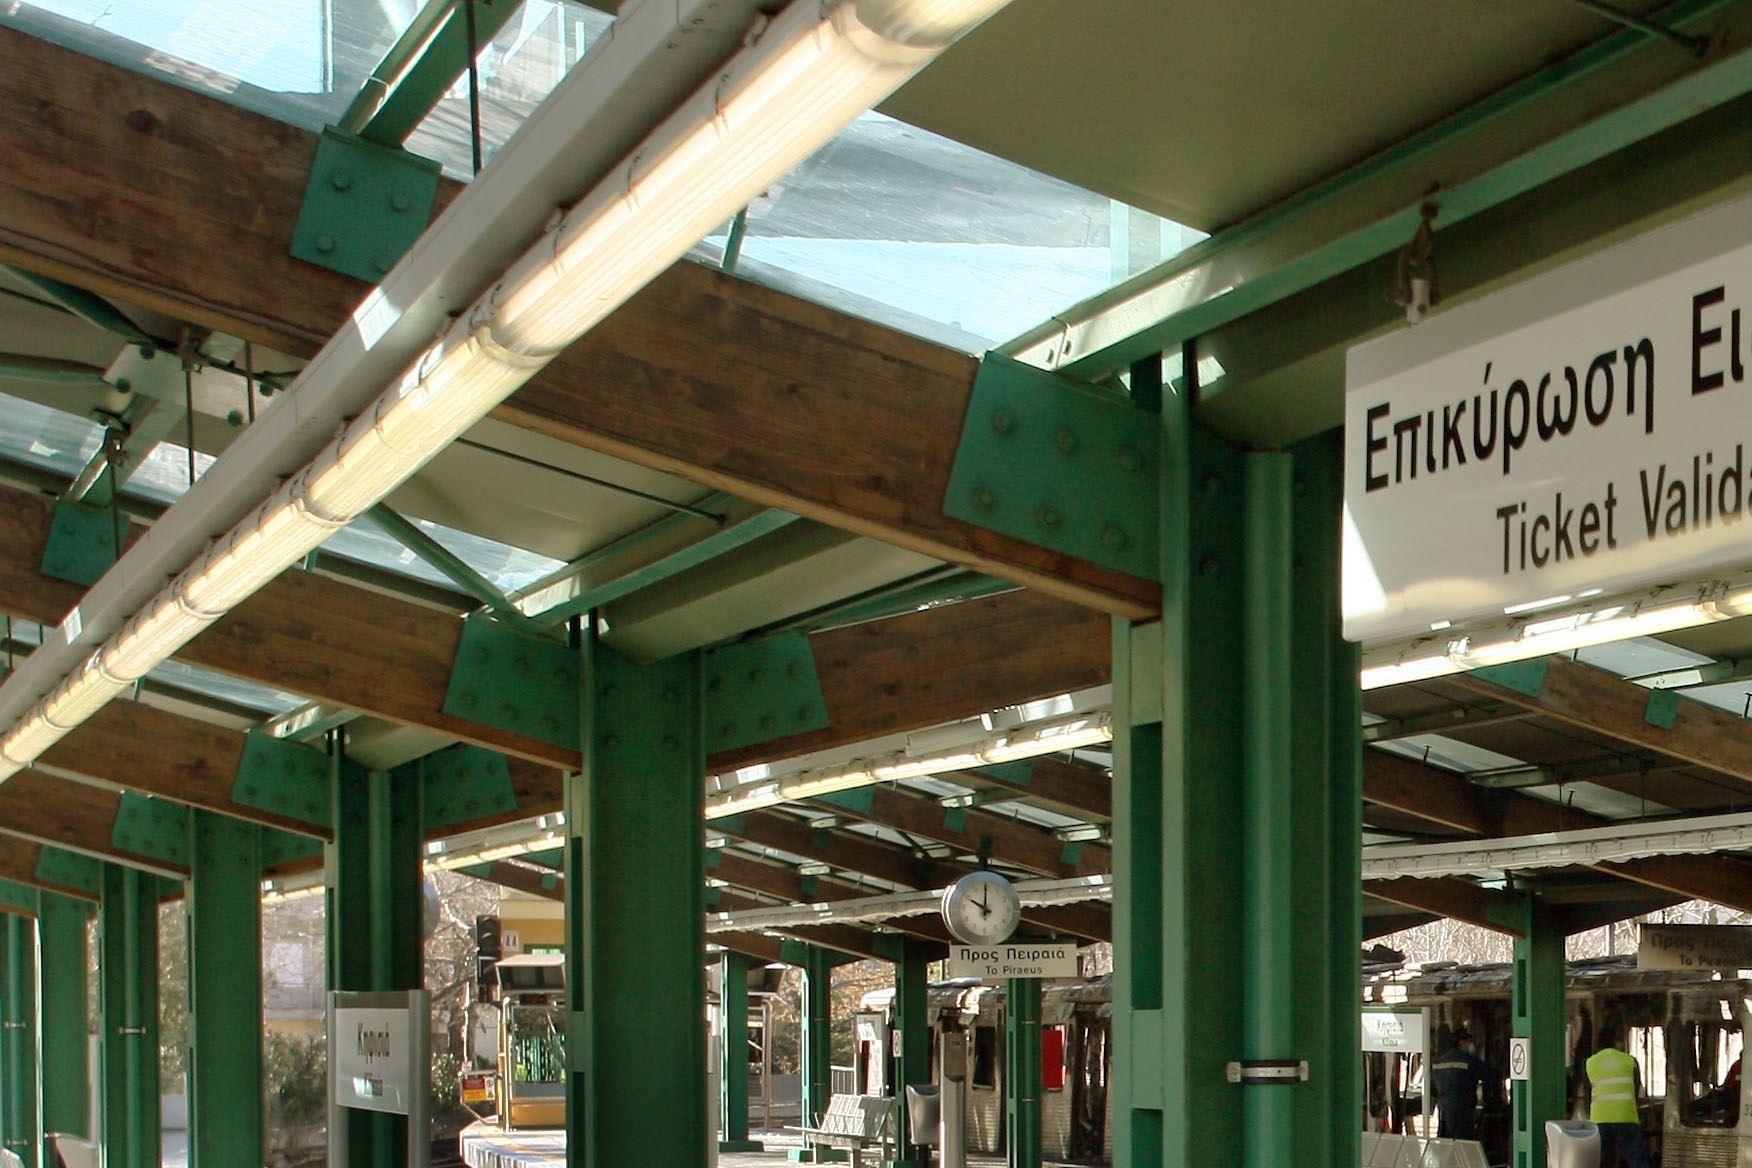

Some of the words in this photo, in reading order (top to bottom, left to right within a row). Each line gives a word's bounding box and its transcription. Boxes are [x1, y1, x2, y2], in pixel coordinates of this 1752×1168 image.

[1365, 336, 1654, 493] Επικύρωση
[1496, 481, 1618, 575] Ticket
[961, 948, 998, 963] Προς
[1007, 946, 1065, 961] Πειραιά
[985, 965, 998, 975] To
[1003, 965, 1043, 975] Piraeus
